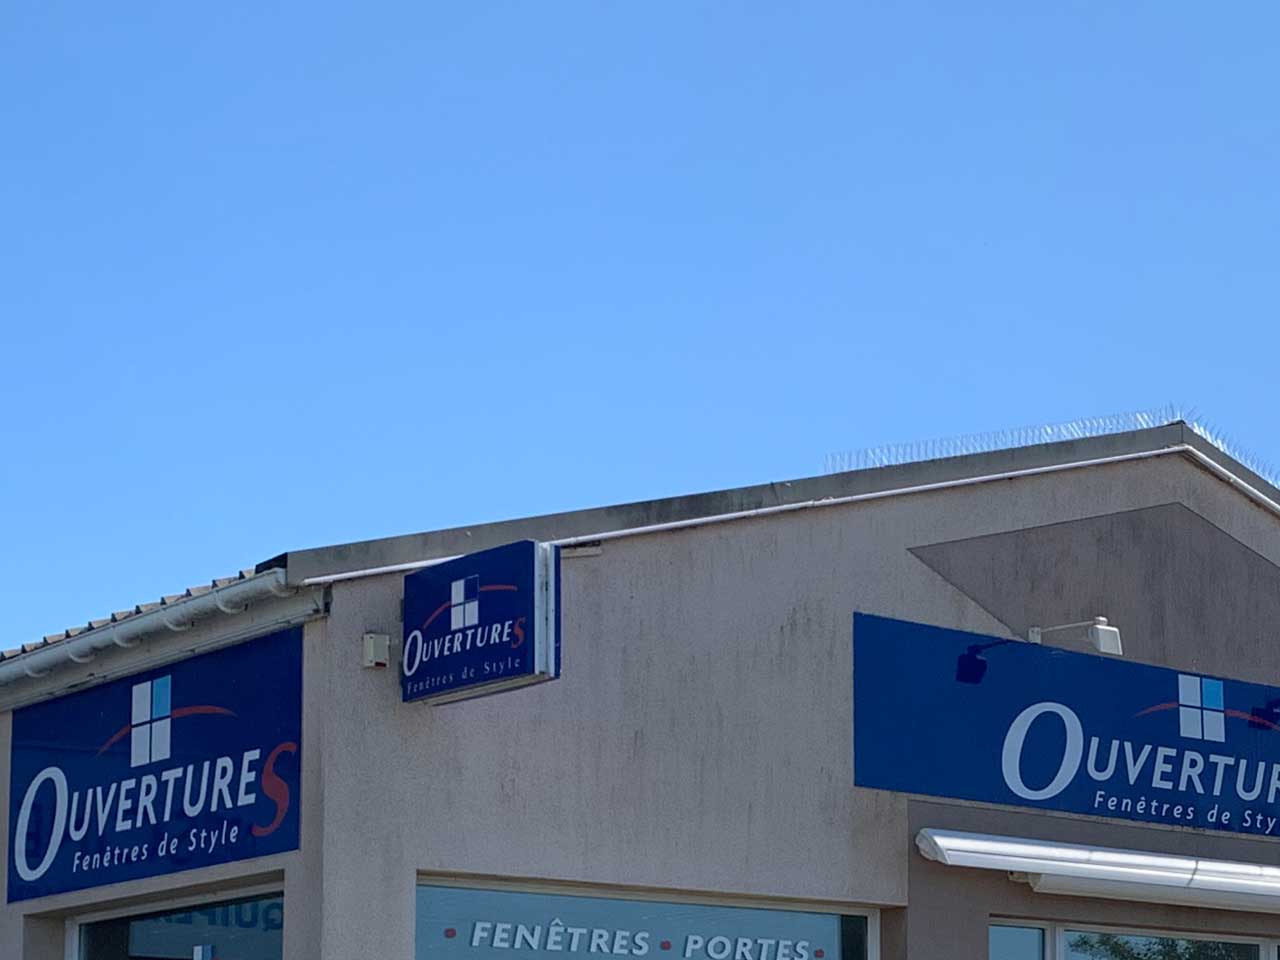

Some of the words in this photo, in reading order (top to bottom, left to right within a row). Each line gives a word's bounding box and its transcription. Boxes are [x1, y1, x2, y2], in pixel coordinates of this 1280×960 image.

[403, 616, 526, 677] OUVERTURES
[407, 673, 454, 695] Fenêtres
[461, 666, 476, 680] de
[484, 657, 521, 675] Style
[14, 742, 297, 882] OUVERTURES
[1095, 791, 1195, 820] Fenêtres
[1208, 805, 1231, 824] de
[73, 842, 149, 873] Fenêtres
[158, 836, 178, 856] de
[189, 823, 239, 853] Style
[471, 918, 650, 956] FENÊTRES
